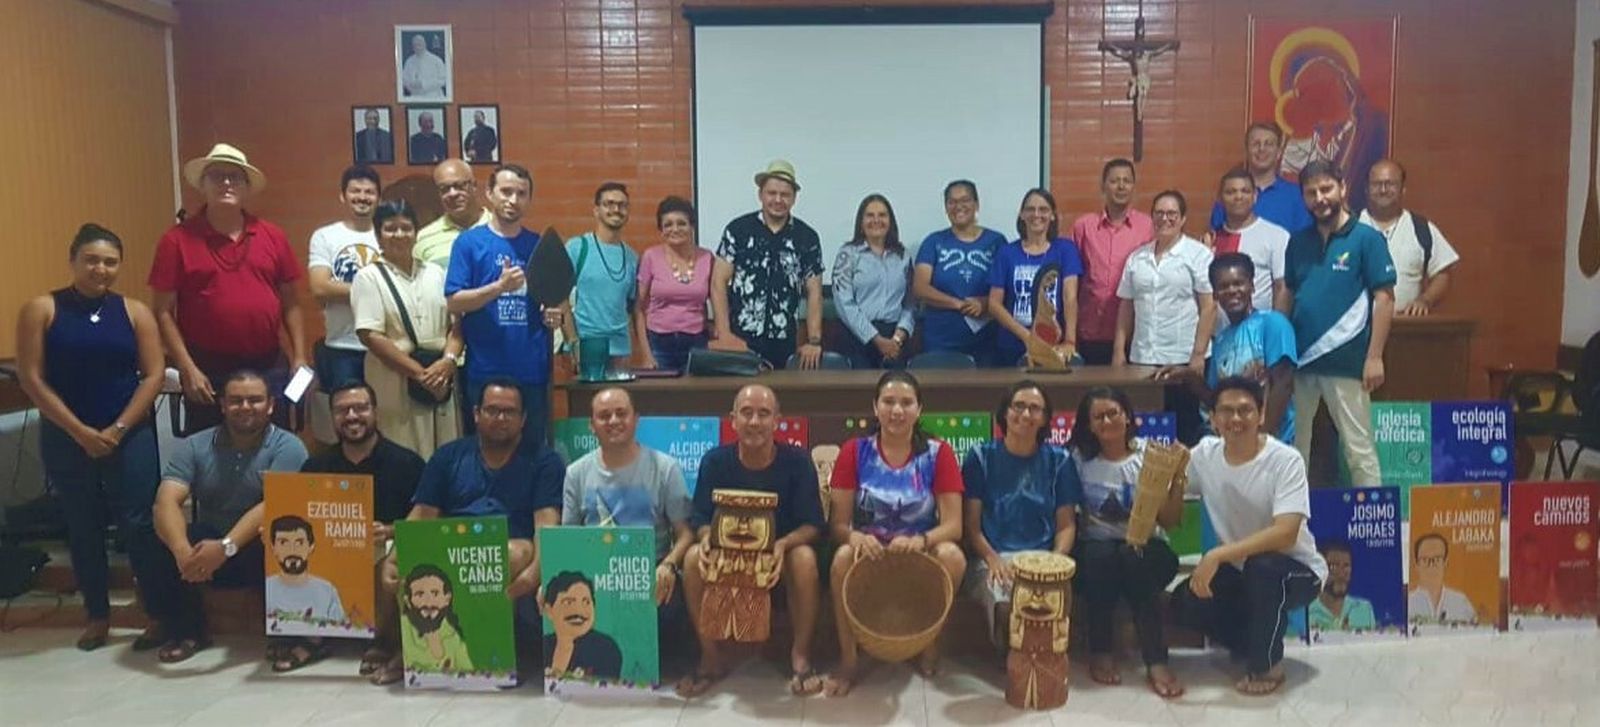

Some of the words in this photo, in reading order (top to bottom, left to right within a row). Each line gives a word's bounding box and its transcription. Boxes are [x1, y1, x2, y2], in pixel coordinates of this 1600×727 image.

[1377, 409, 1421, 431] iglesia
[1452, 406, 1506, 428] ecología
[1374, 427, 1425, 443] rofética
[1457, 424, 1507, 445] integral
[307, 501, 366, 519] EZEQUIEL
[1351, 504, 1395, 521] JOSIMO
[1543, 495, 1590, 512] nuevos
[1432, 509, 1495, 528] ALEJANDRO
[1534, 510, 1589, 526] caminos
[325, 521, 366, 538] RAMIN
[1348, 522, 1395, 540] MORAES
[1452, 527, 1495, 544] LABAKA
[447, 546, 502, 565] VICENTE
[459, 563, 503, 583] CAÑAS
[609, 556, 650, 574] CHICO
[594, 573, 650, 592] MENDES
